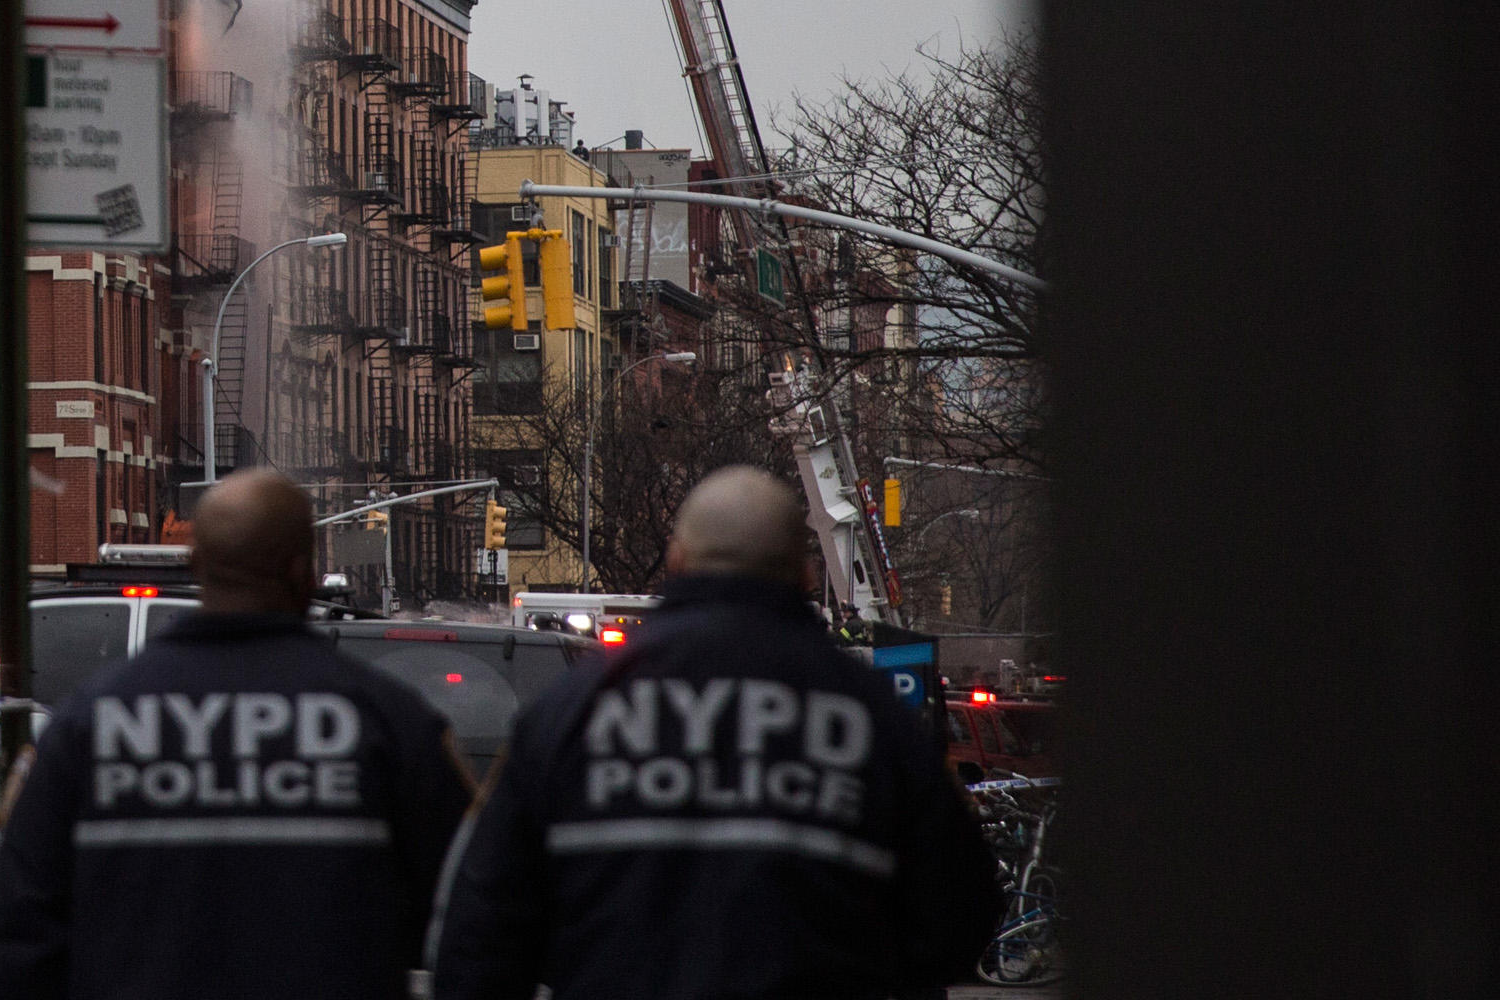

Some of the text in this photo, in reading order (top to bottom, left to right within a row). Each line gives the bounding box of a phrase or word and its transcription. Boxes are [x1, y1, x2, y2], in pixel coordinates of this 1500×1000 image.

[94, 691, 362, 759] NYPD
[586, 677, 873, 768] NYPD
[95, 759, 362, 808] POLICE
[586, 756, 865, 823] POLICE
